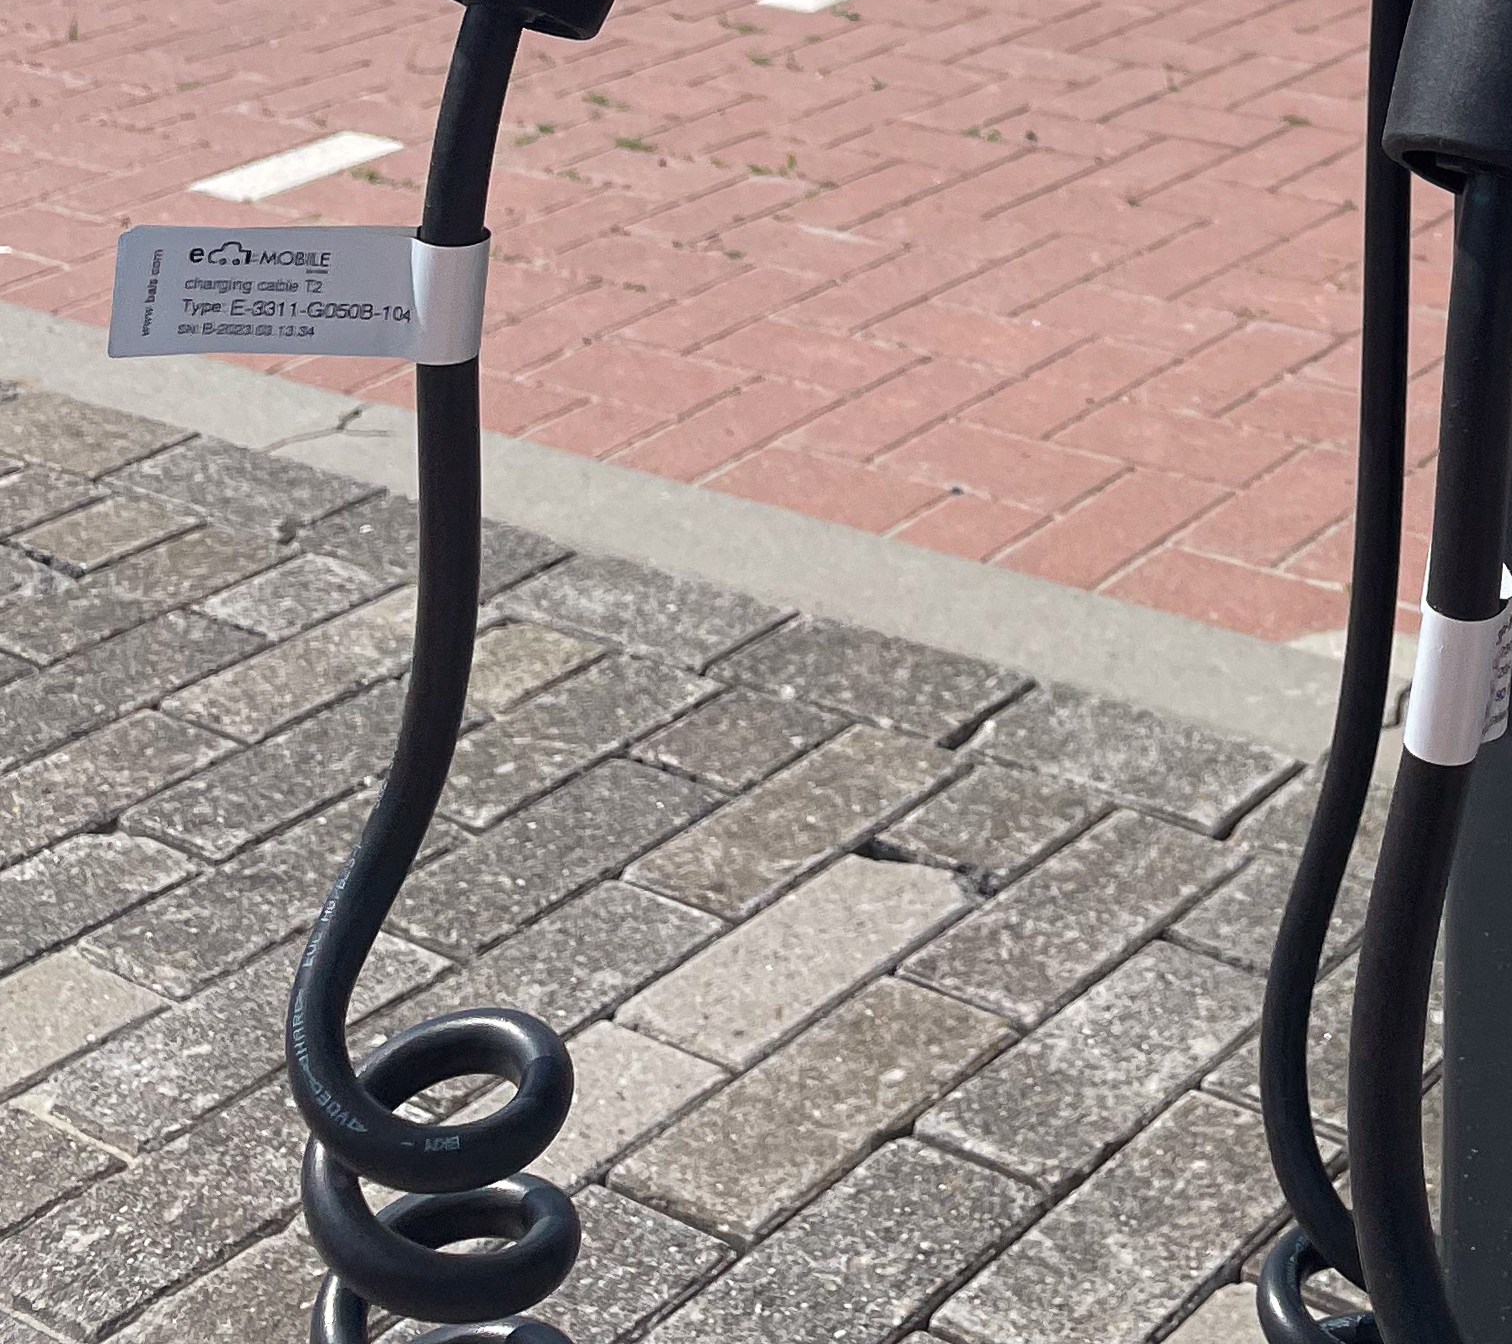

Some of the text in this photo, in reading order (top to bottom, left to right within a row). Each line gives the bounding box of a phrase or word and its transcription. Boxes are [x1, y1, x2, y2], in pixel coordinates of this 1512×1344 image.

[184, 277, 324, 294] charging cable T2
